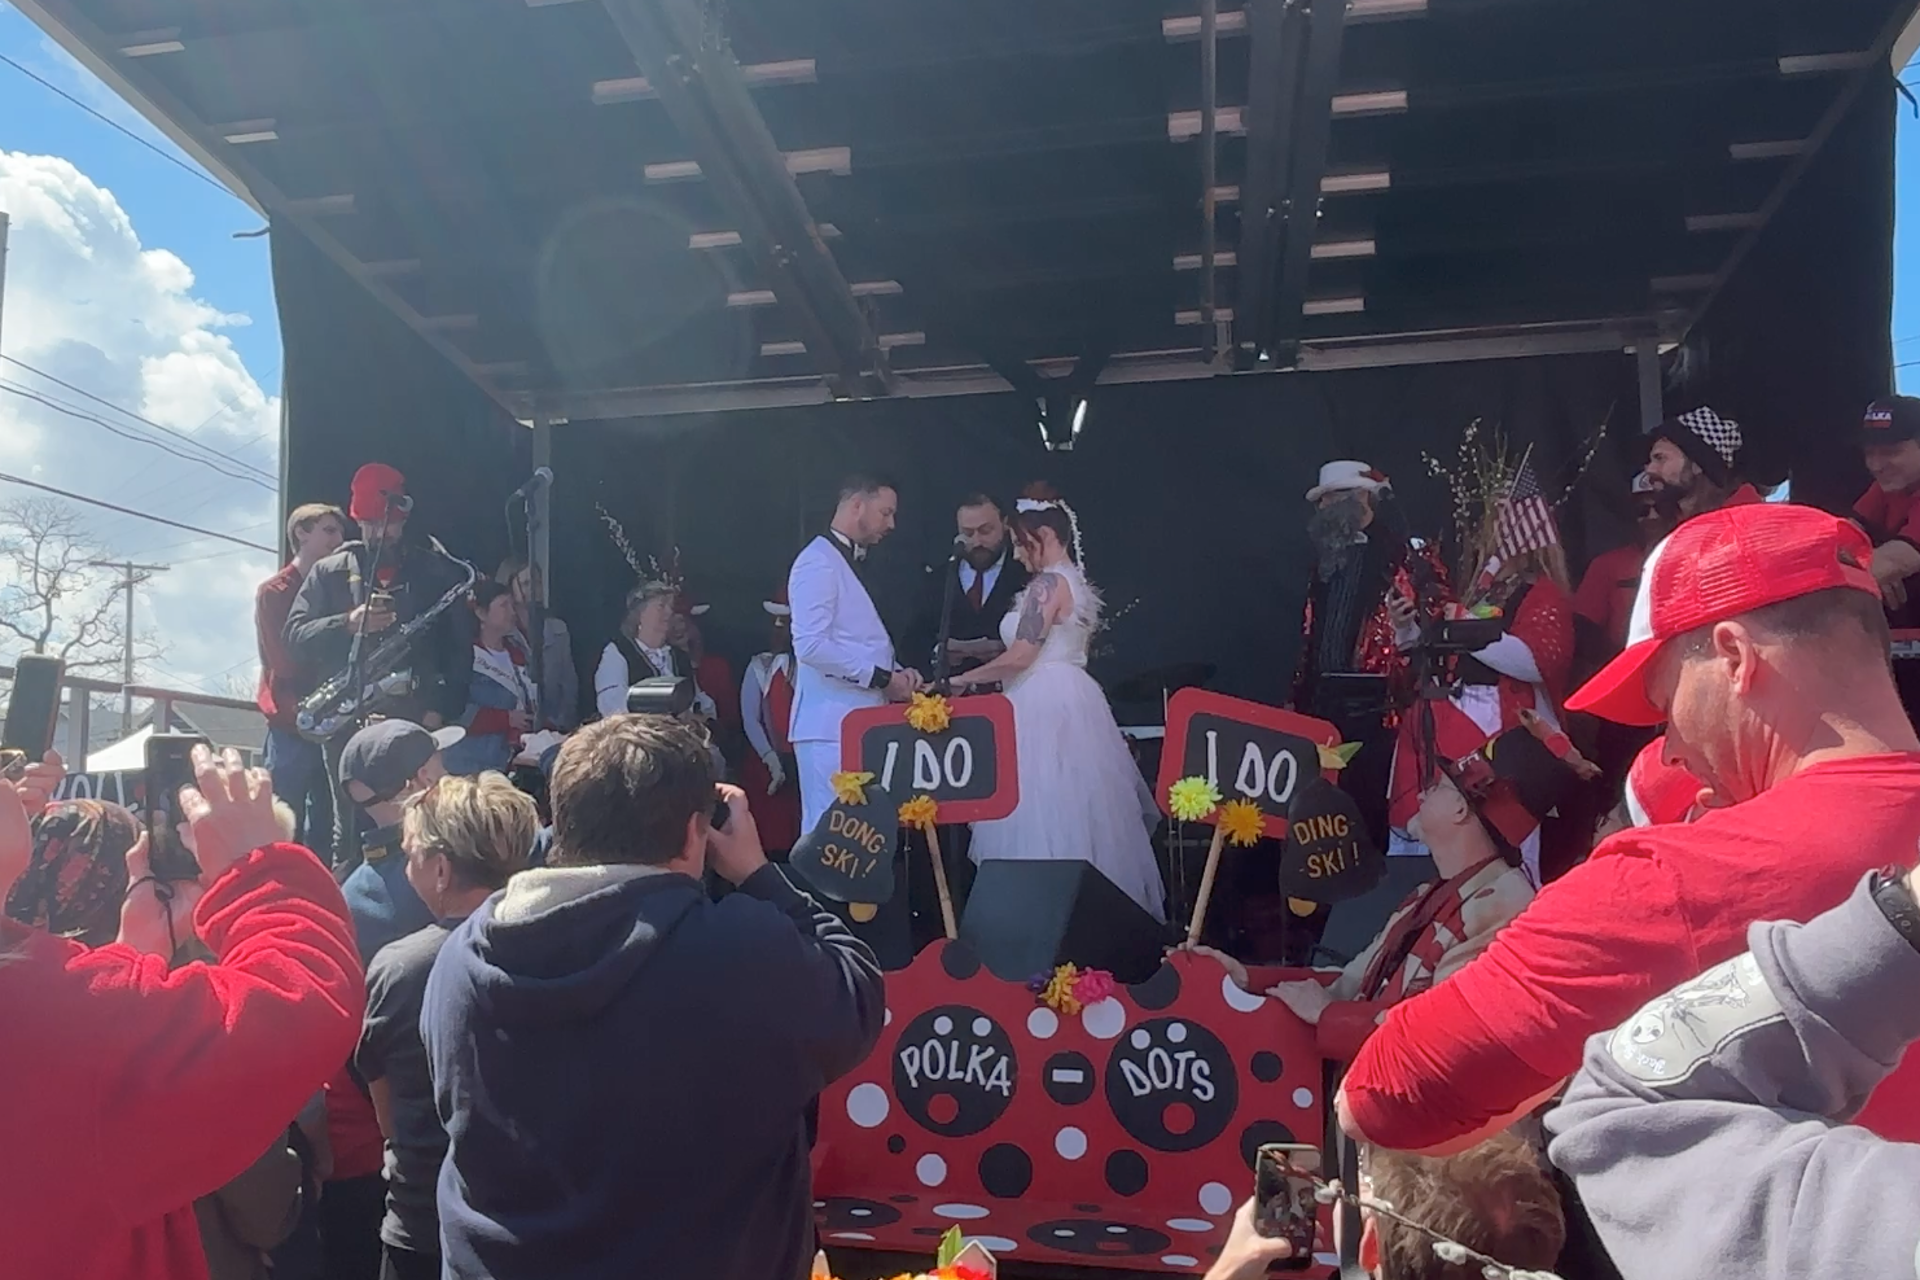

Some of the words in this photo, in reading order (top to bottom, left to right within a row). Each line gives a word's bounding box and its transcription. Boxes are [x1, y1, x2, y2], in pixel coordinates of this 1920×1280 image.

[881, 741, 899, 792] I
[912, 736, 973, 791] DO
[1206, 730, 1218, 786] I
[1234, 741, 1298, 803] DO
[900, 1038, 1013, 1097] POLKA
[1119, 1047, 1215, 1102] DOTS
